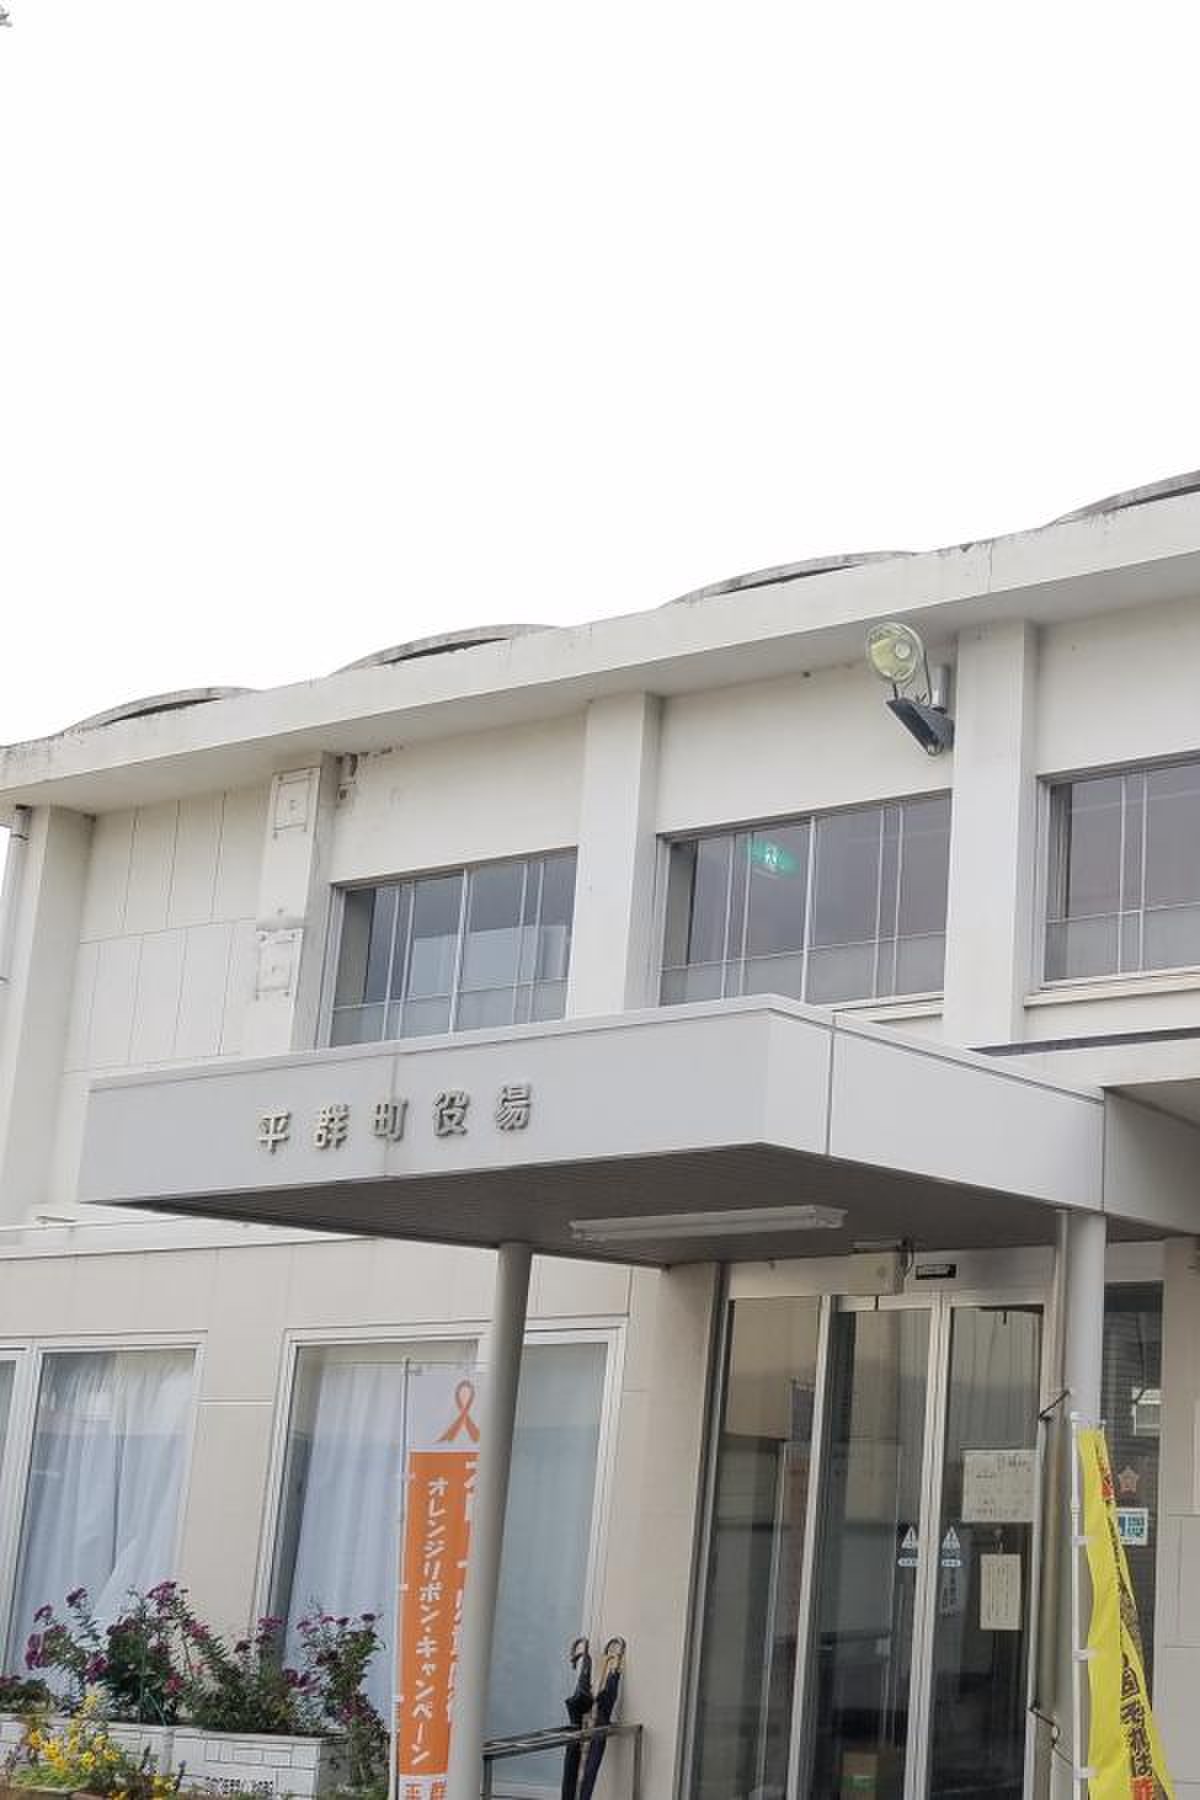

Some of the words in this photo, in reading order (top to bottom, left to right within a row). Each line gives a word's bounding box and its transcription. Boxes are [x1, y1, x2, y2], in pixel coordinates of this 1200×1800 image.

[256, 1083, 533, 1154] 平群町役場
